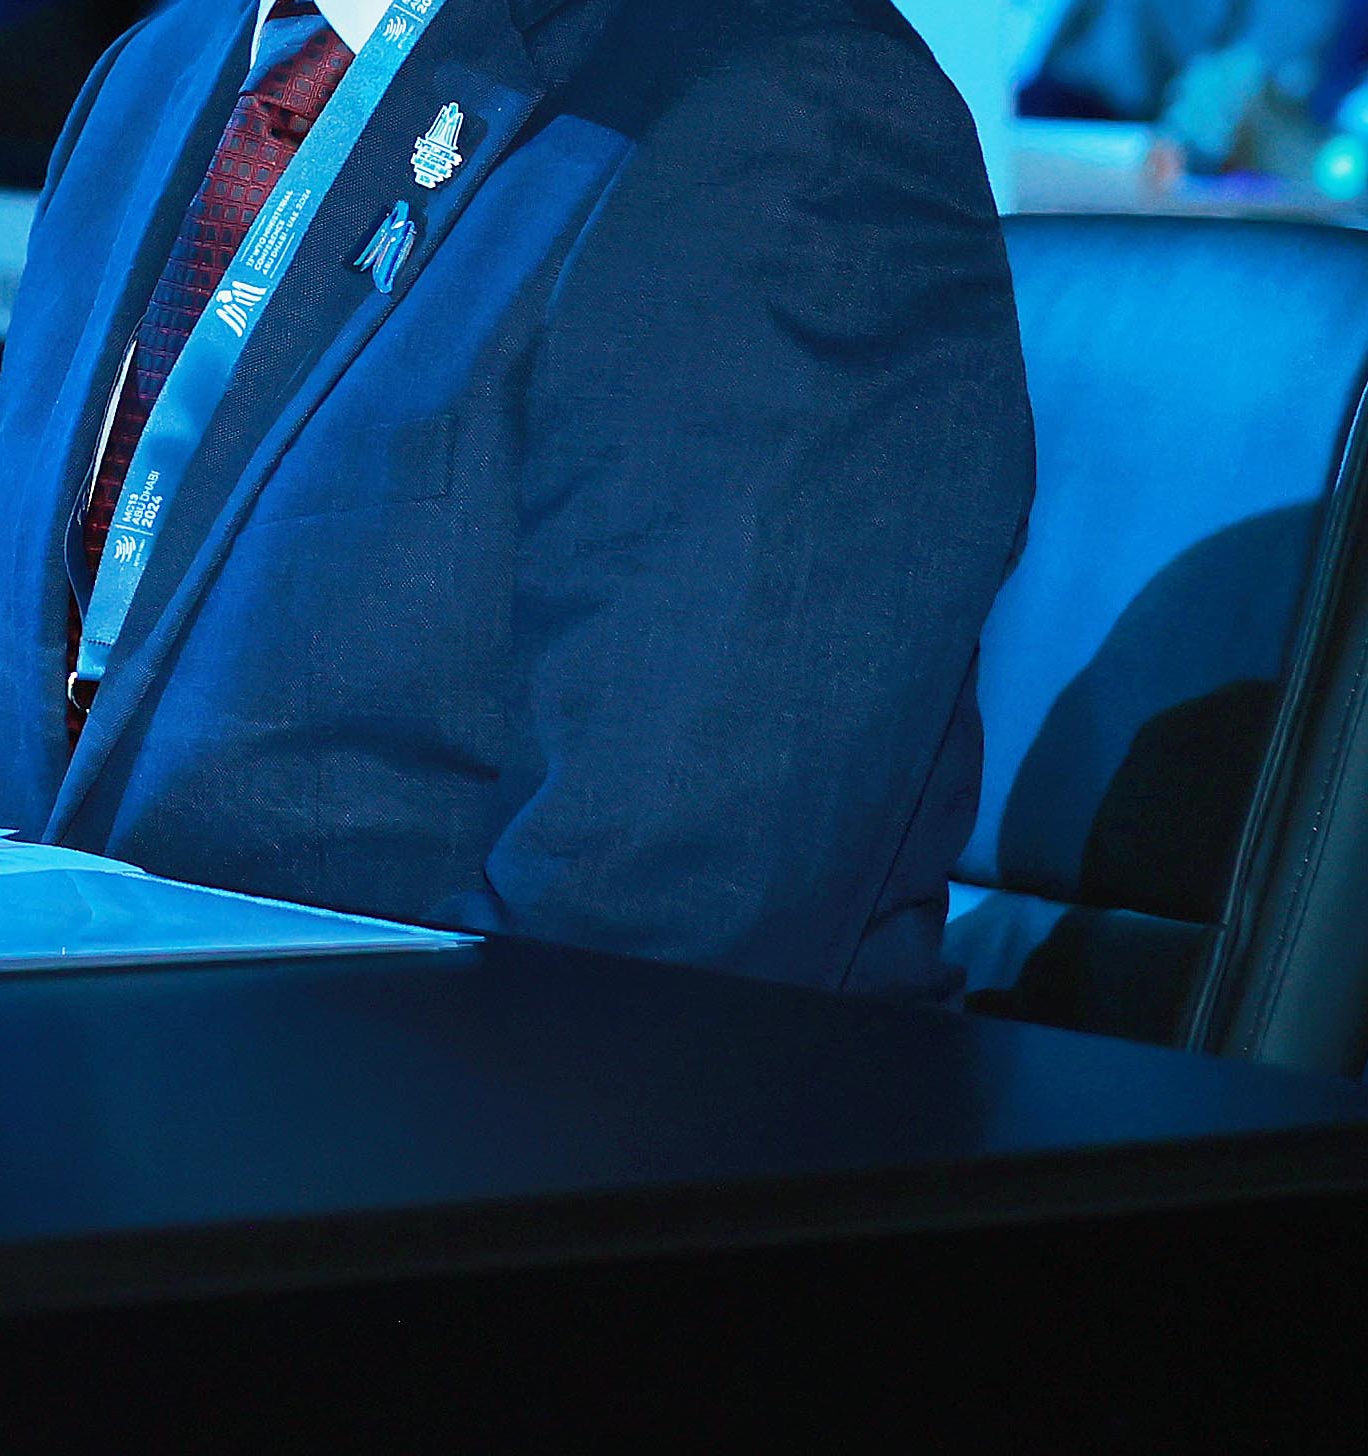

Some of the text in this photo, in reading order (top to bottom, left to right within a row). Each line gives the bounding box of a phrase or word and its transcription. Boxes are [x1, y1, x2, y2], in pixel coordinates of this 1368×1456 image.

[122, 493, 139, 522] MC13
[131, 502, 146, 525] ABU
[139, 470, 160, 502] DHABI
[141, 495, 163, 528] 2024
